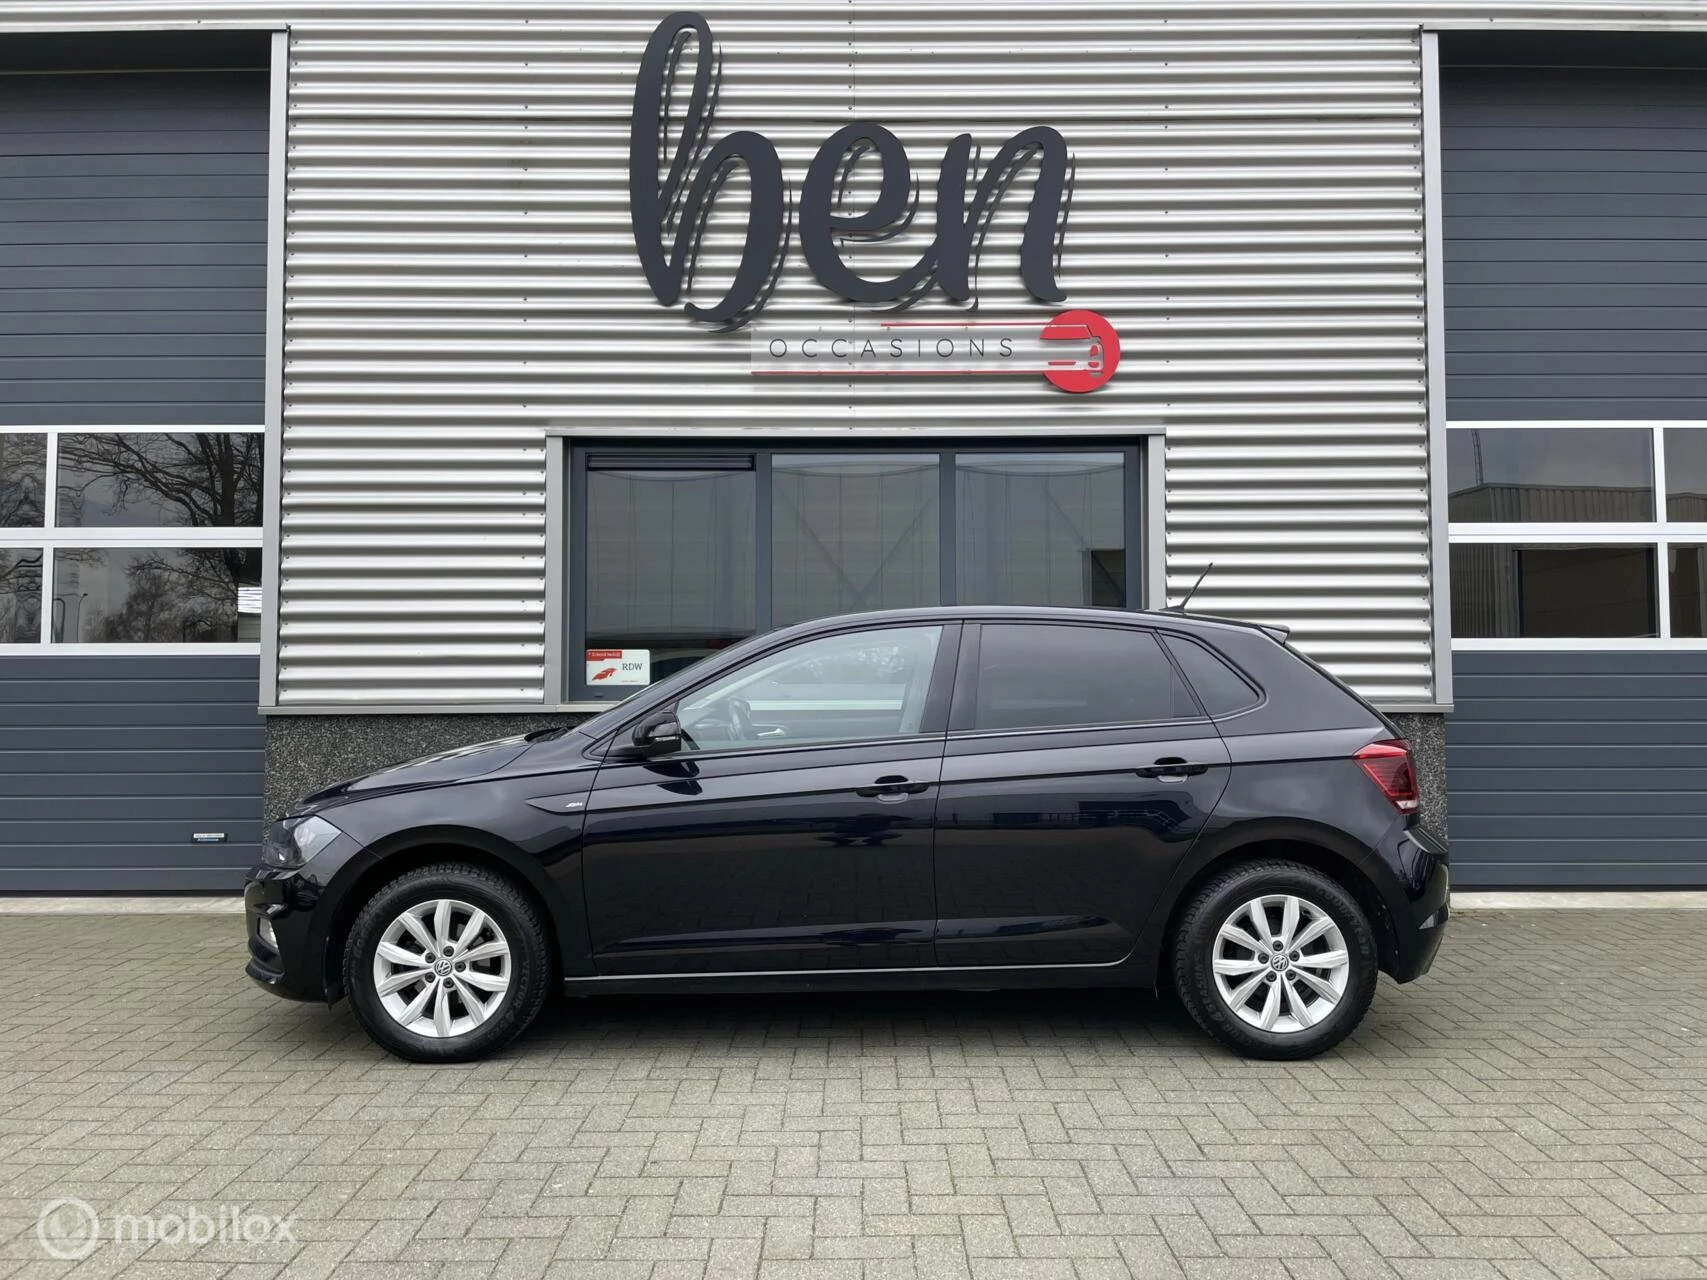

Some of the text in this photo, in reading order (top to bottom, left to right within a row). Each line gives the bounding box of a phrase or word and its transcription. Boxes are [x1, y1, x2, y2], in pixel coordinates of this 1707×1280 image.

[630, 11, 1068, 322] ben
[769, 338, 1012, 358] OCCASIONS
[622, 663, 643, 671] RDW
